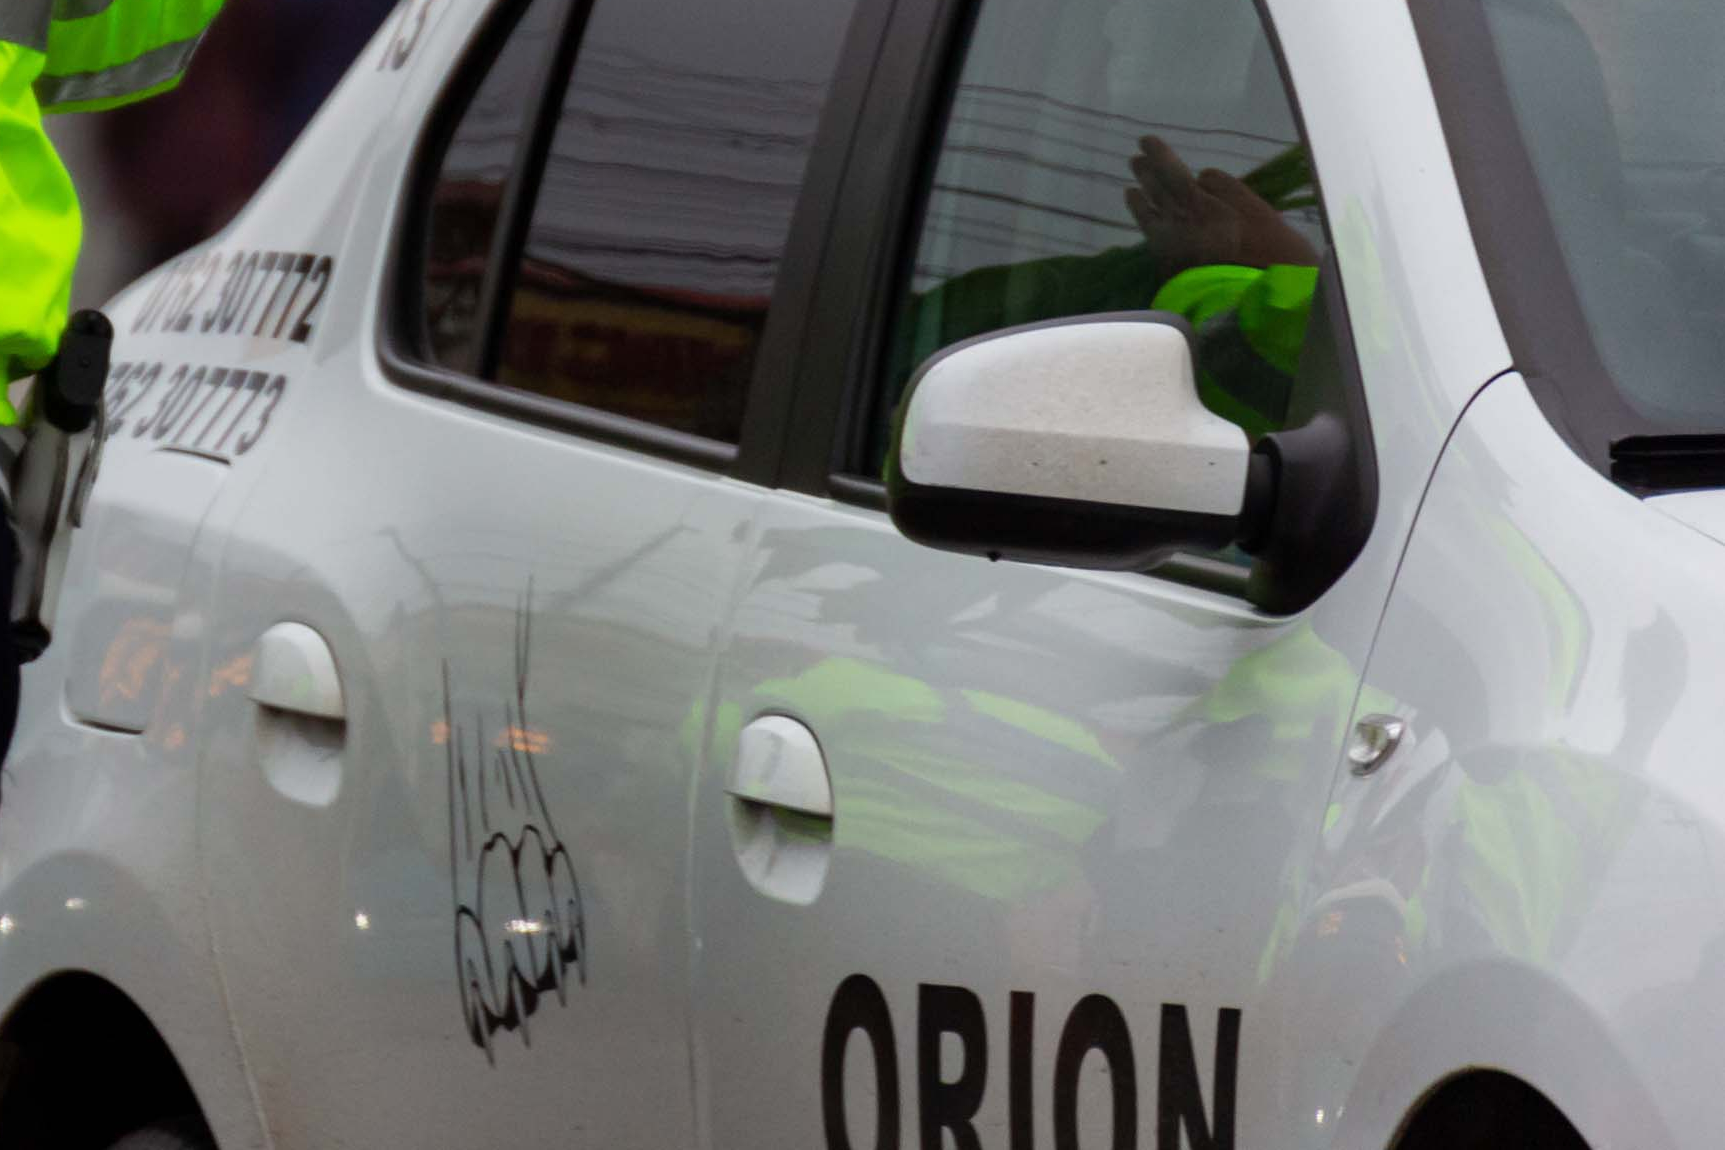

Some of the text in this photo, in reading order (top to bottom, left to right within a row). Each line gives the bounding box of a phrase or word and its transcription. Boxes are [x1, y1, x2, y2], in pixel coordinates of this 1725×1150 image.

[199, 250, 334, 343] 307772
[132, 362, 287, 455] 307773
[821, 973, 1242, 1150] ORION
